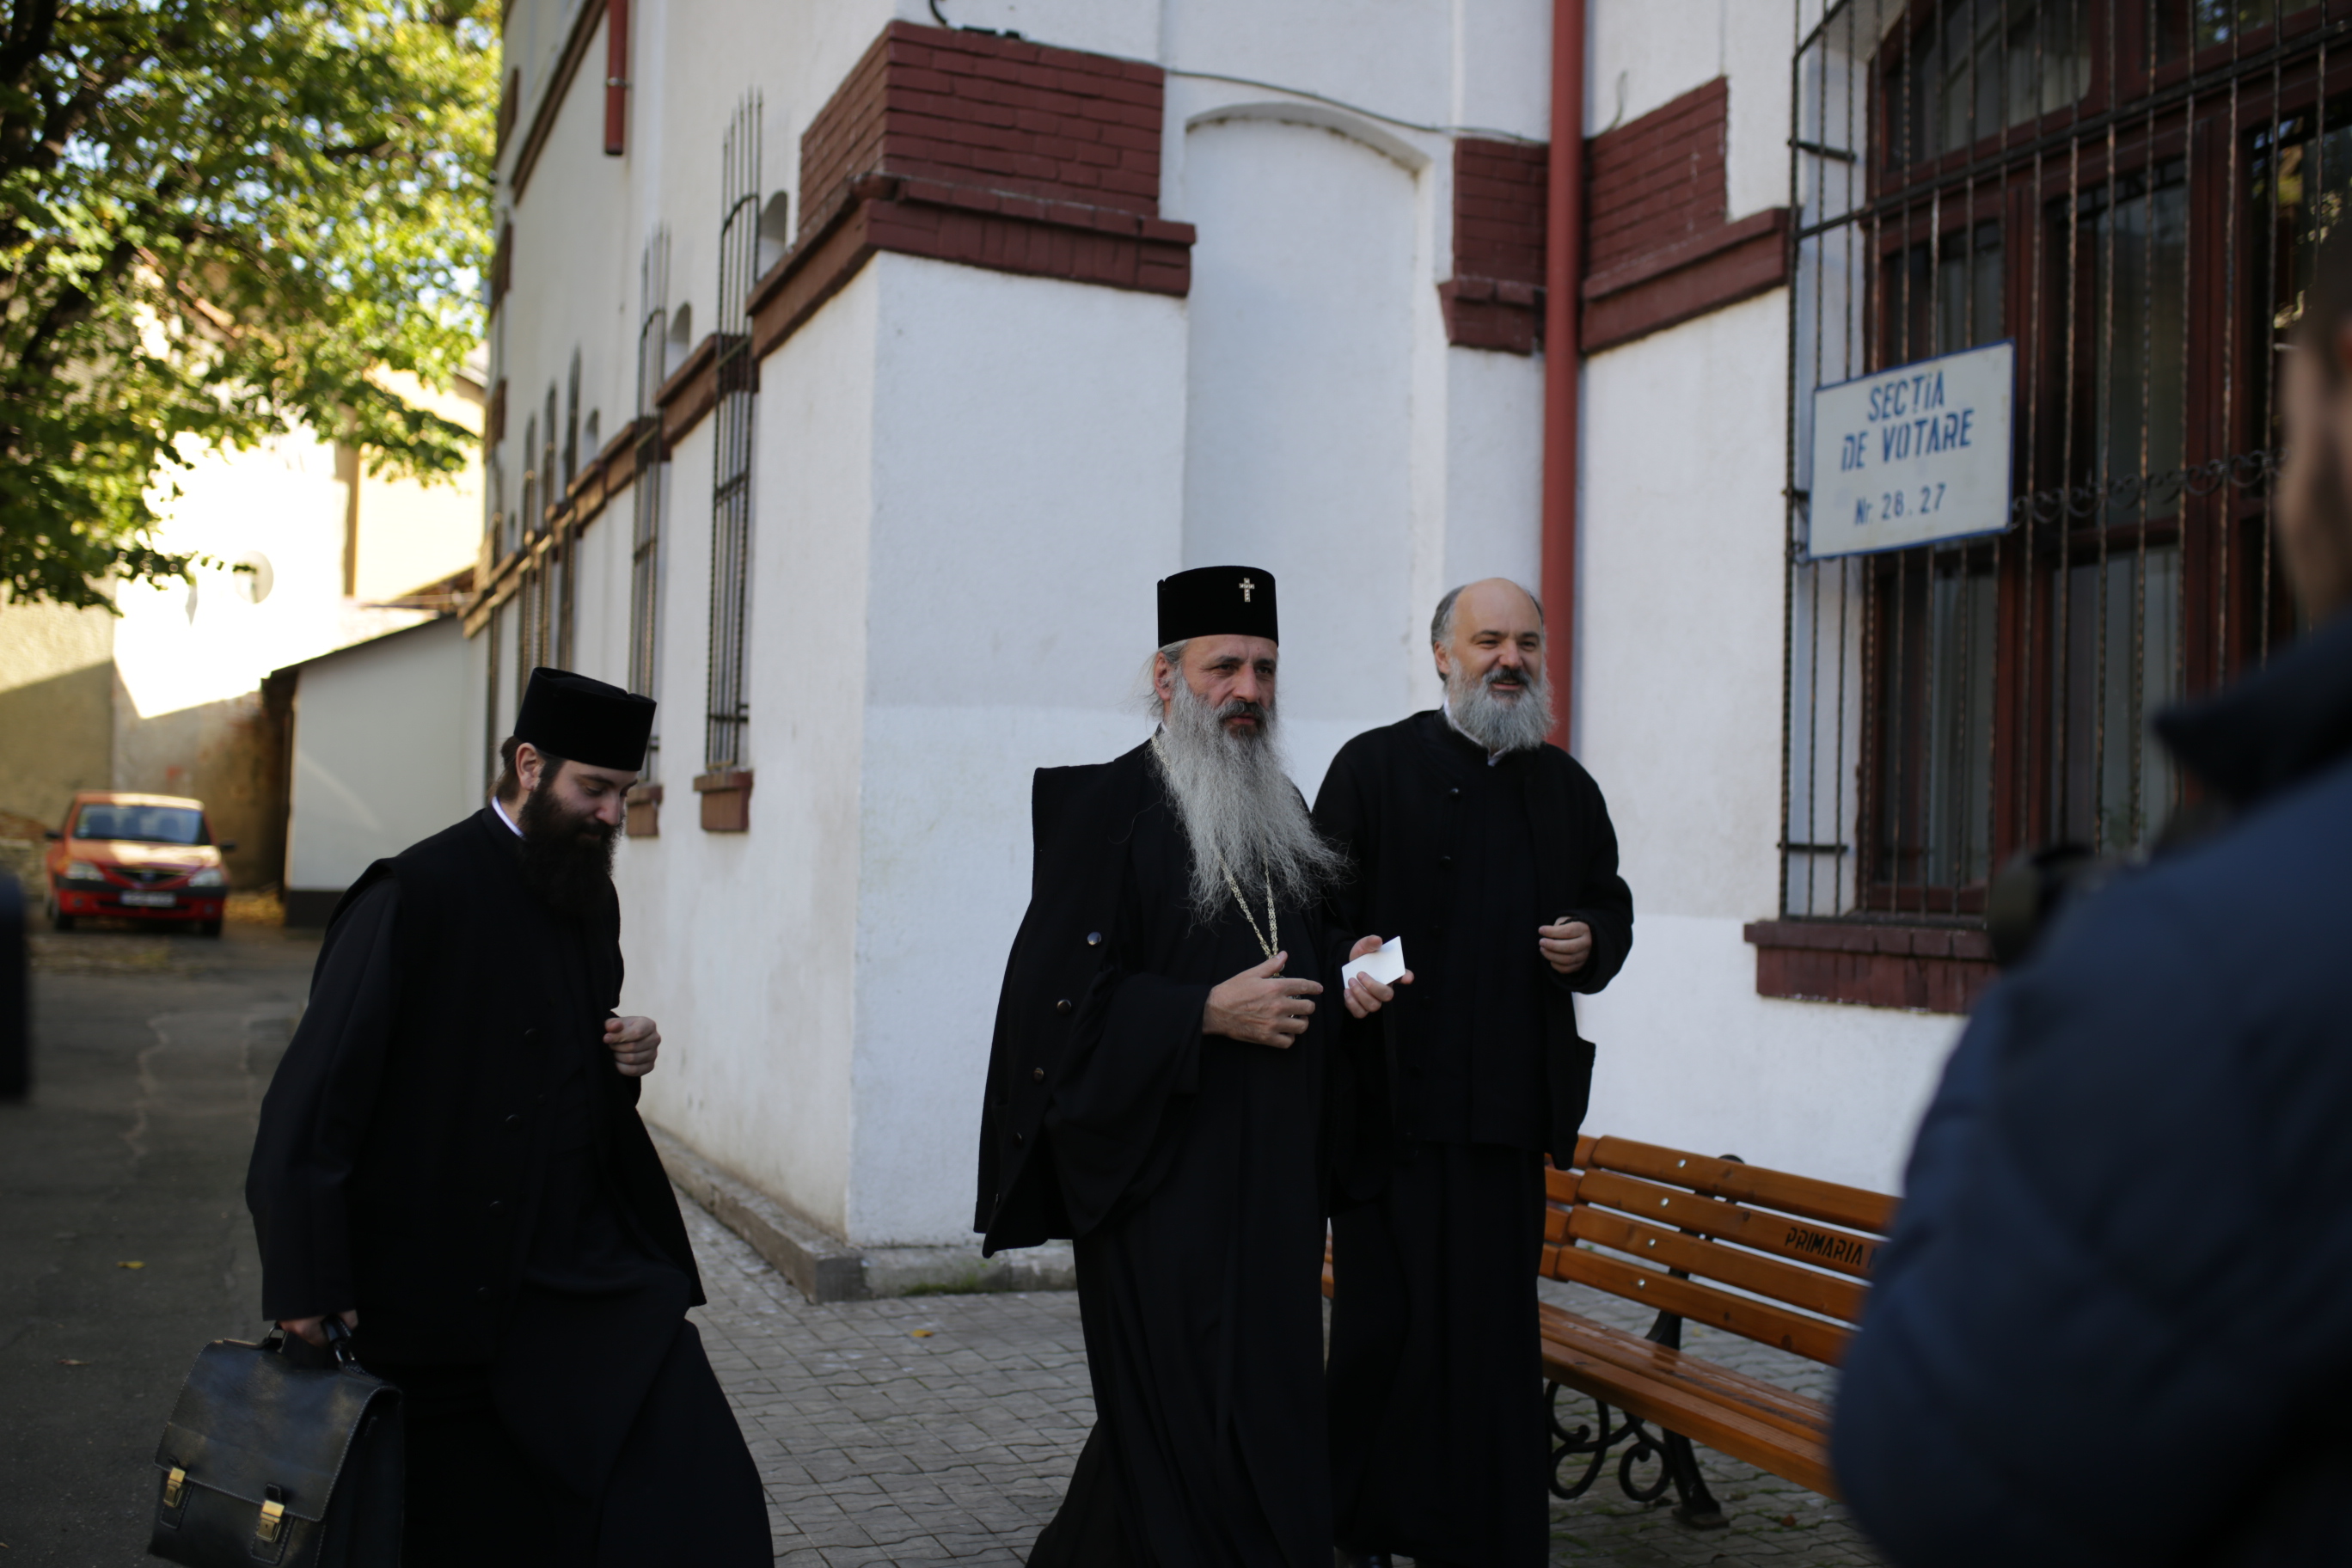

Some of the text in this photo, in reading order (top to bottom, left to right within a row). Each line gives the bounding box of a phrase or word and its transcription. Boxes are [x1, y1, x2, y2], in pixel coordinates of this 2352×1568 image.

[1841, 408, 1975, 471] DE VOTARE
[1785, 1227, 1864, 1266] PRIMARIA
